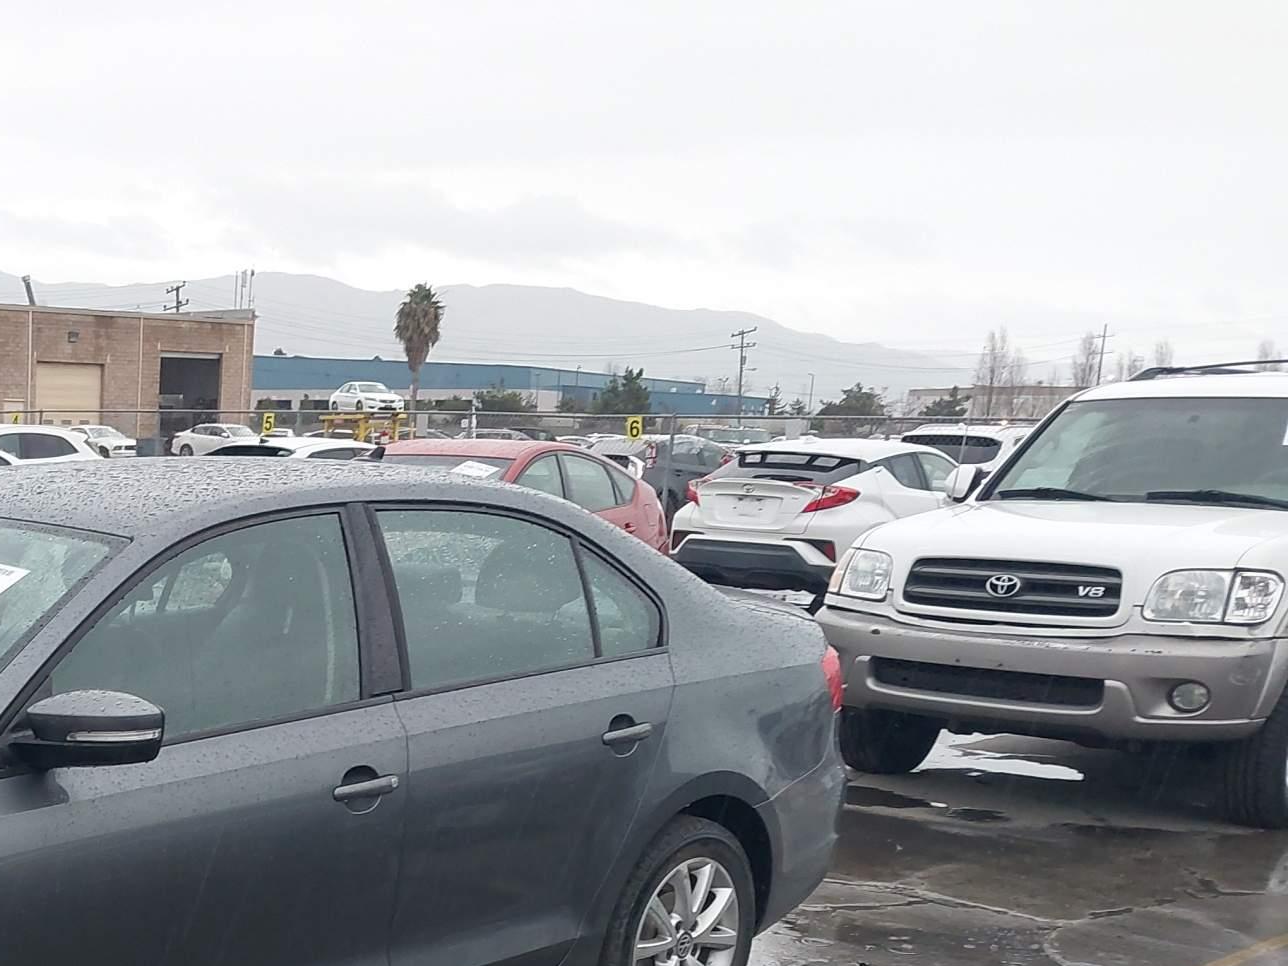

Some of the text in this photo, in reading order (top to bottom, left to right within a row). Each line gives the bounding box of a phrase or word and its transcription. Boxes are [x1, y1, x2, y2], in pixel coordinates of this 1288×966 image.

[264, 415, 273, 431] 5
[630, 420, 640, 438] 6
[1078, 585, 1106, 598] V8
